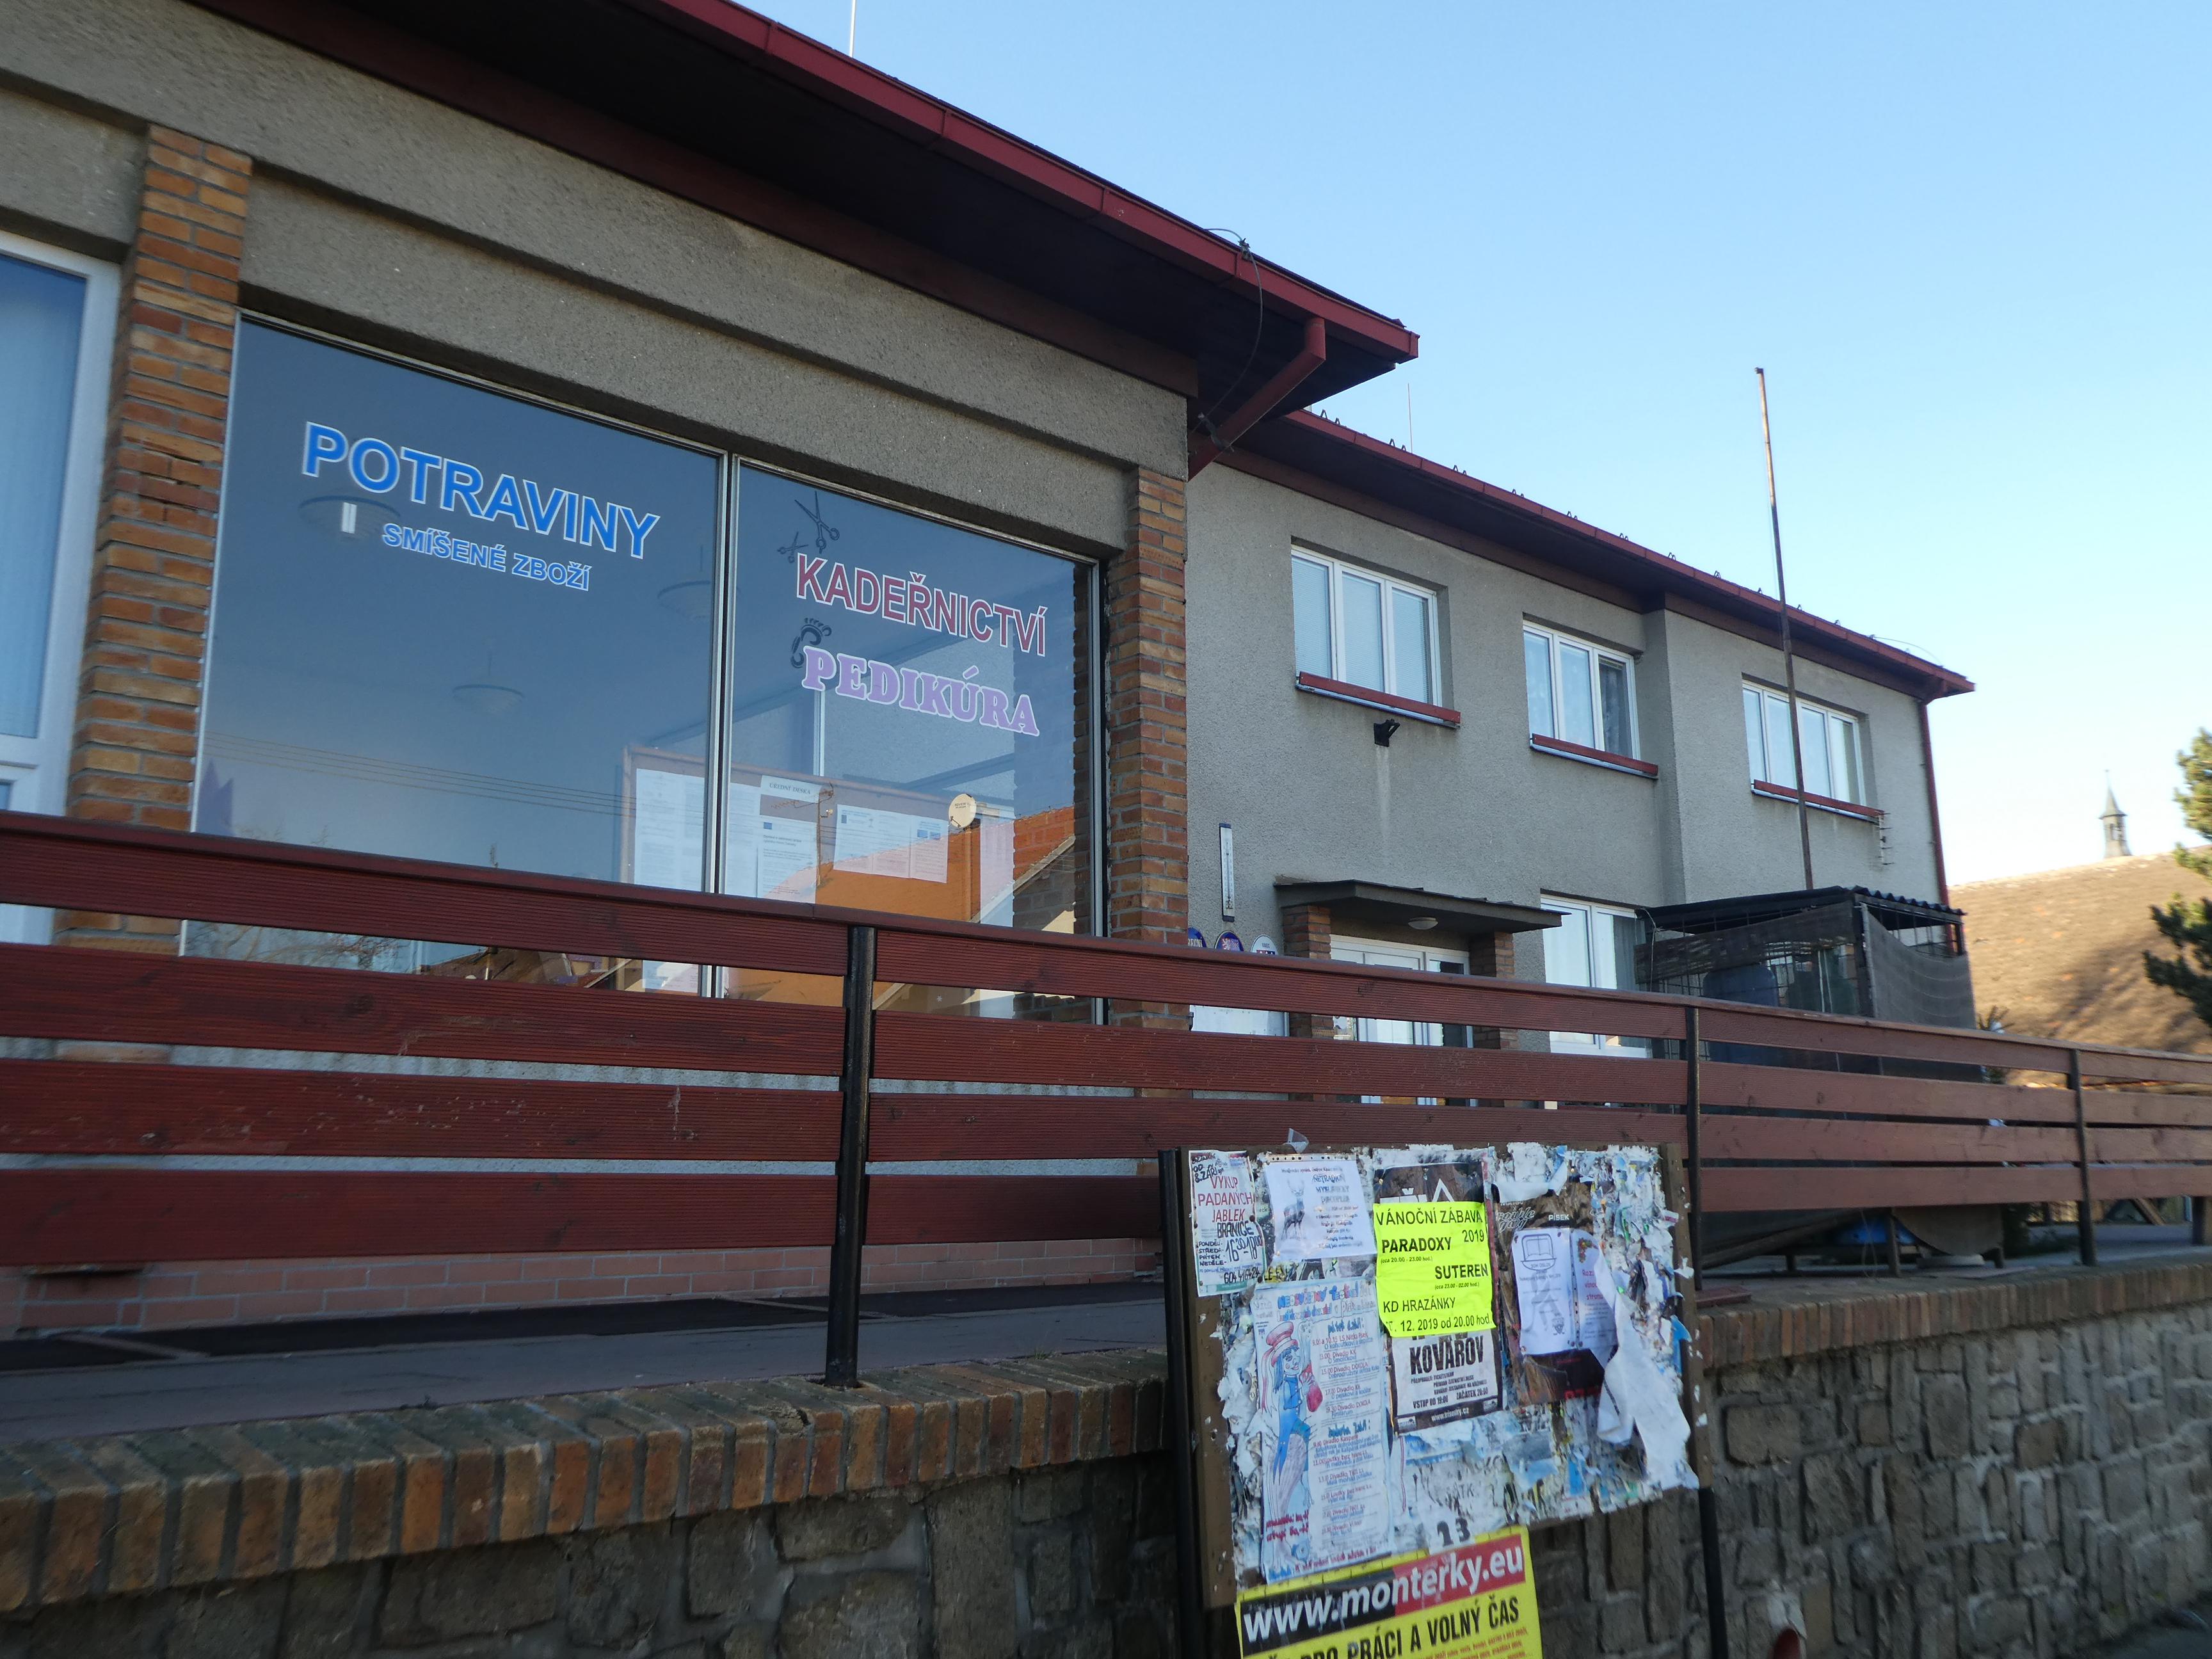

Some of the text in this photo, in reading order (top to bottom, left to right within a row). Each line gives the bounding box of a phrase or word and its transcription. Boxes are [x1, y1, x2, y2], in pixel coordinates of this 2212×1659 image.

[302, 421, 660, 559] POTRAVINY
[382, 523, 592, 591] SMÍŠENÉ ZBOŽÍ
[797, 552, 1048, 657] KADEŘNICTVÍ
[801, 646, 1040, 736] PEDIKÚRA
[1212, 1209, 1246, 1222] JABLEK
[1376, 1206, 1483, 1226] VÁNOČNÍ ZÁBAVA
[1548, 1213, 1570, 1221] PÍSEK
[1382, 1237, 1452, 1253] PARADOXY
[1462, 1230, 1484, 1242] 2019
[1435, 1263, 1489, 1279] SUTEREN
[1383, 1301, 1399, 1313] KD
[1402, 1295, 1455, 1312] HRAZÁNKY
[1400, 1320, 1415, 1332] 12.
[1418, 1318, 1438, 1331] 2019
[1441, 1317, 1451, 1329] od
[1454, 1315, 1475, 1327] 20.00
[1413, 1399, 1429, 1409] VSTUP
[1244, 1546, 1523, 1643] www.monterky.eu
[1411, 1623, 1422, 1653] A
[1427, 1599, 1481, 1647] VOLNÝ
[1488, 1594, 1519, 1629] ČAS
